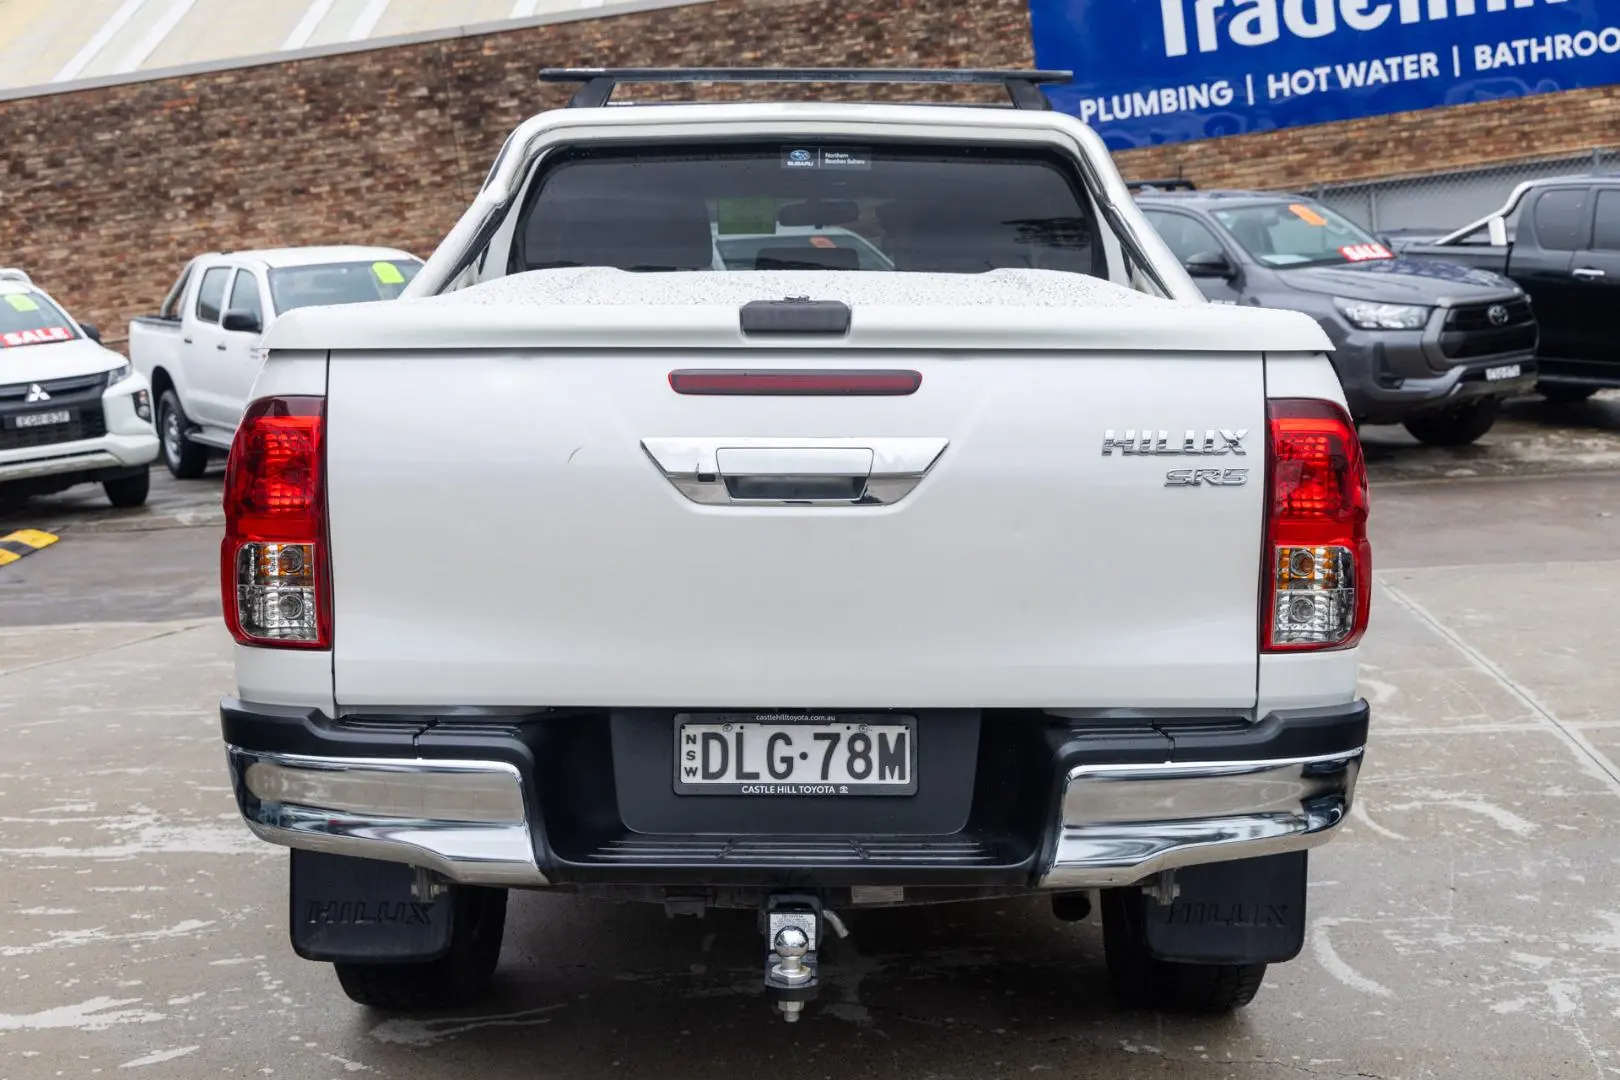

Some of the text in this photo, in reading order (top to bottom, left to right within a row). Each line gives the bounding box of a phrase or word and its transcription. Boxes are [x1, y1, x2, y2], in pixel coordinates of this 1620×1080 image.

[1079, 27, 1620, 123] PLUMBING HOT WATER BATHROO
[1342, 244, 1392, 260] SALE
[4, 328, 69, 345] SALE
[1101, 429, 1249, 456] HILUX
[1164, 468, 1249, 487] SR5
[756, 714, 836, 722] castlehilltoyota.com.au
[741, 785, 835, 794] CASTLE HILL TOYOTA
[309, 901, 435, 924] HILUX
